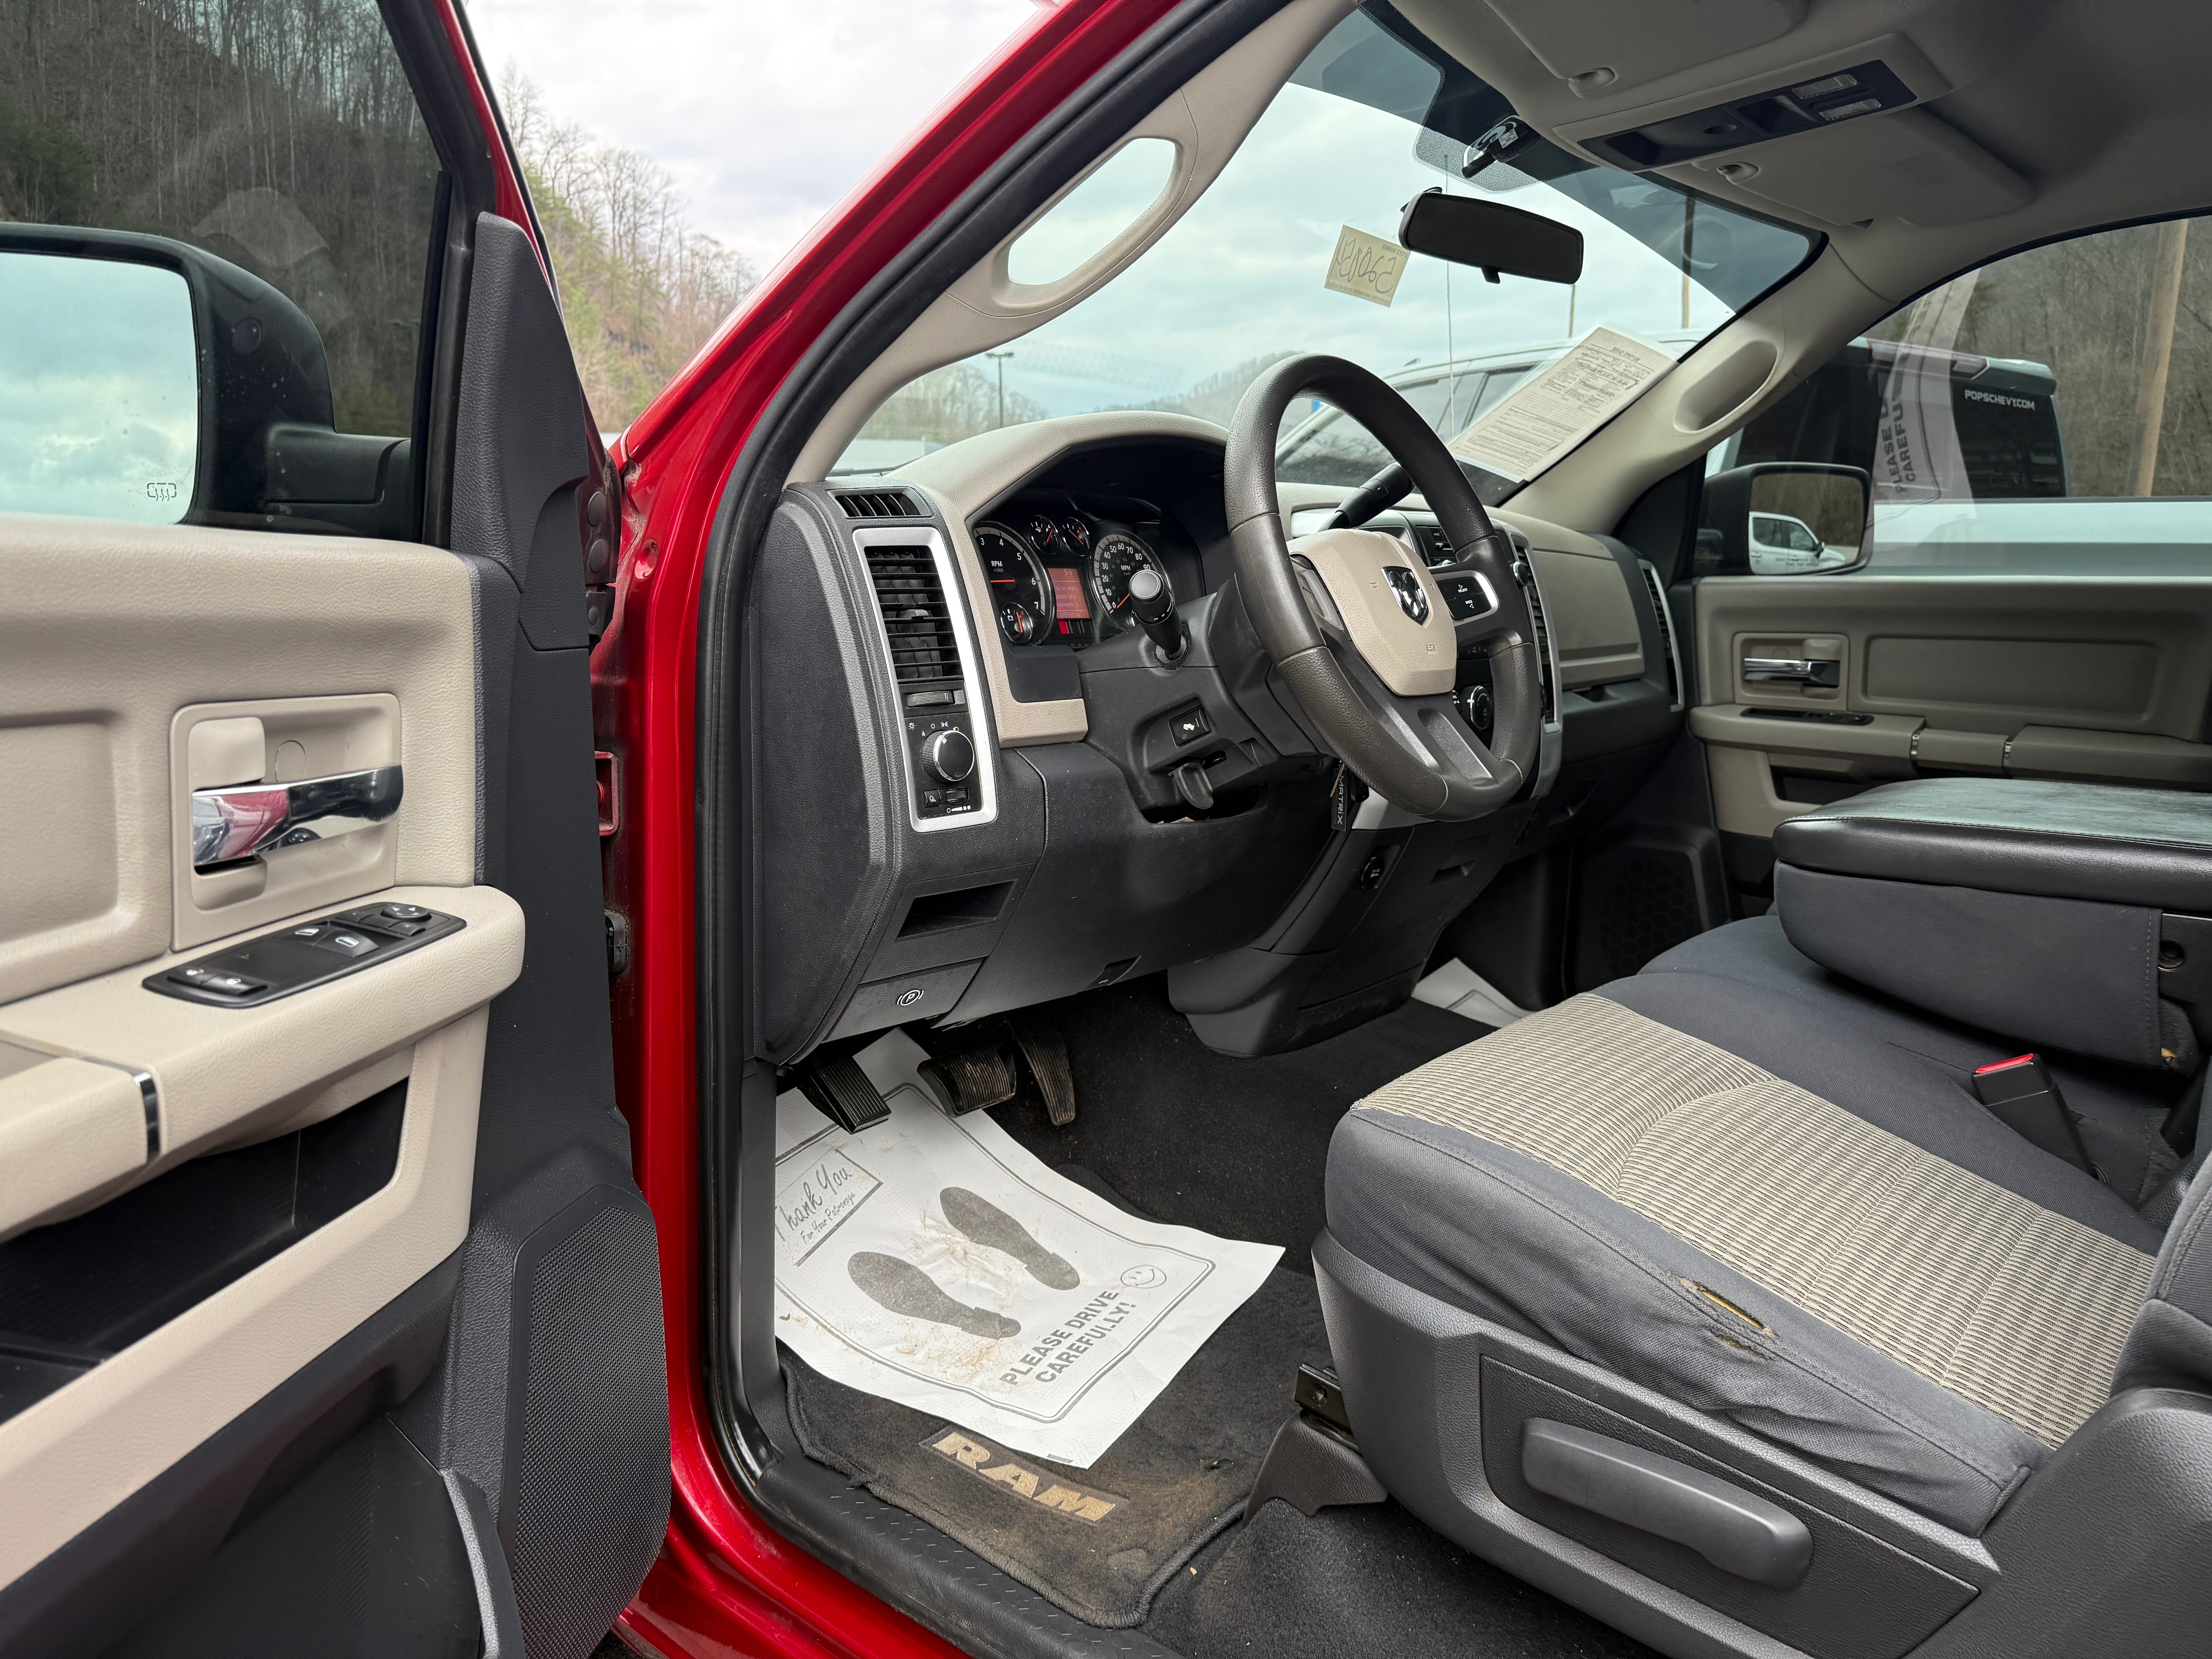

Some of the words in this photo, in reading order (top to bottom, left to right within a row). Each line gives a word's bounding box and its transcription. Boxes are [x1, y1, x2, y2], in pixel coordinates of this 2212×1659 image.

[1891, 402, 1916, 482] CAREFU
[999, 539, 1004, 547] 4
[1017, 553, 1022, 561] 5
[816, 1164, 852, 1195] You
[800, 1230, 814, 1243] For
[812, 1221, 827, 1232] Your
[825, 1192, 855, 1220] Patronage
[998, 1329, 1073, 1385] PLEASE
[1064, 1291, 1120, 1329] DRIVE
[1035, 1302, 1137, 1382] CAREFULLY!
[932, 1432, 1116, 1521] RAM
